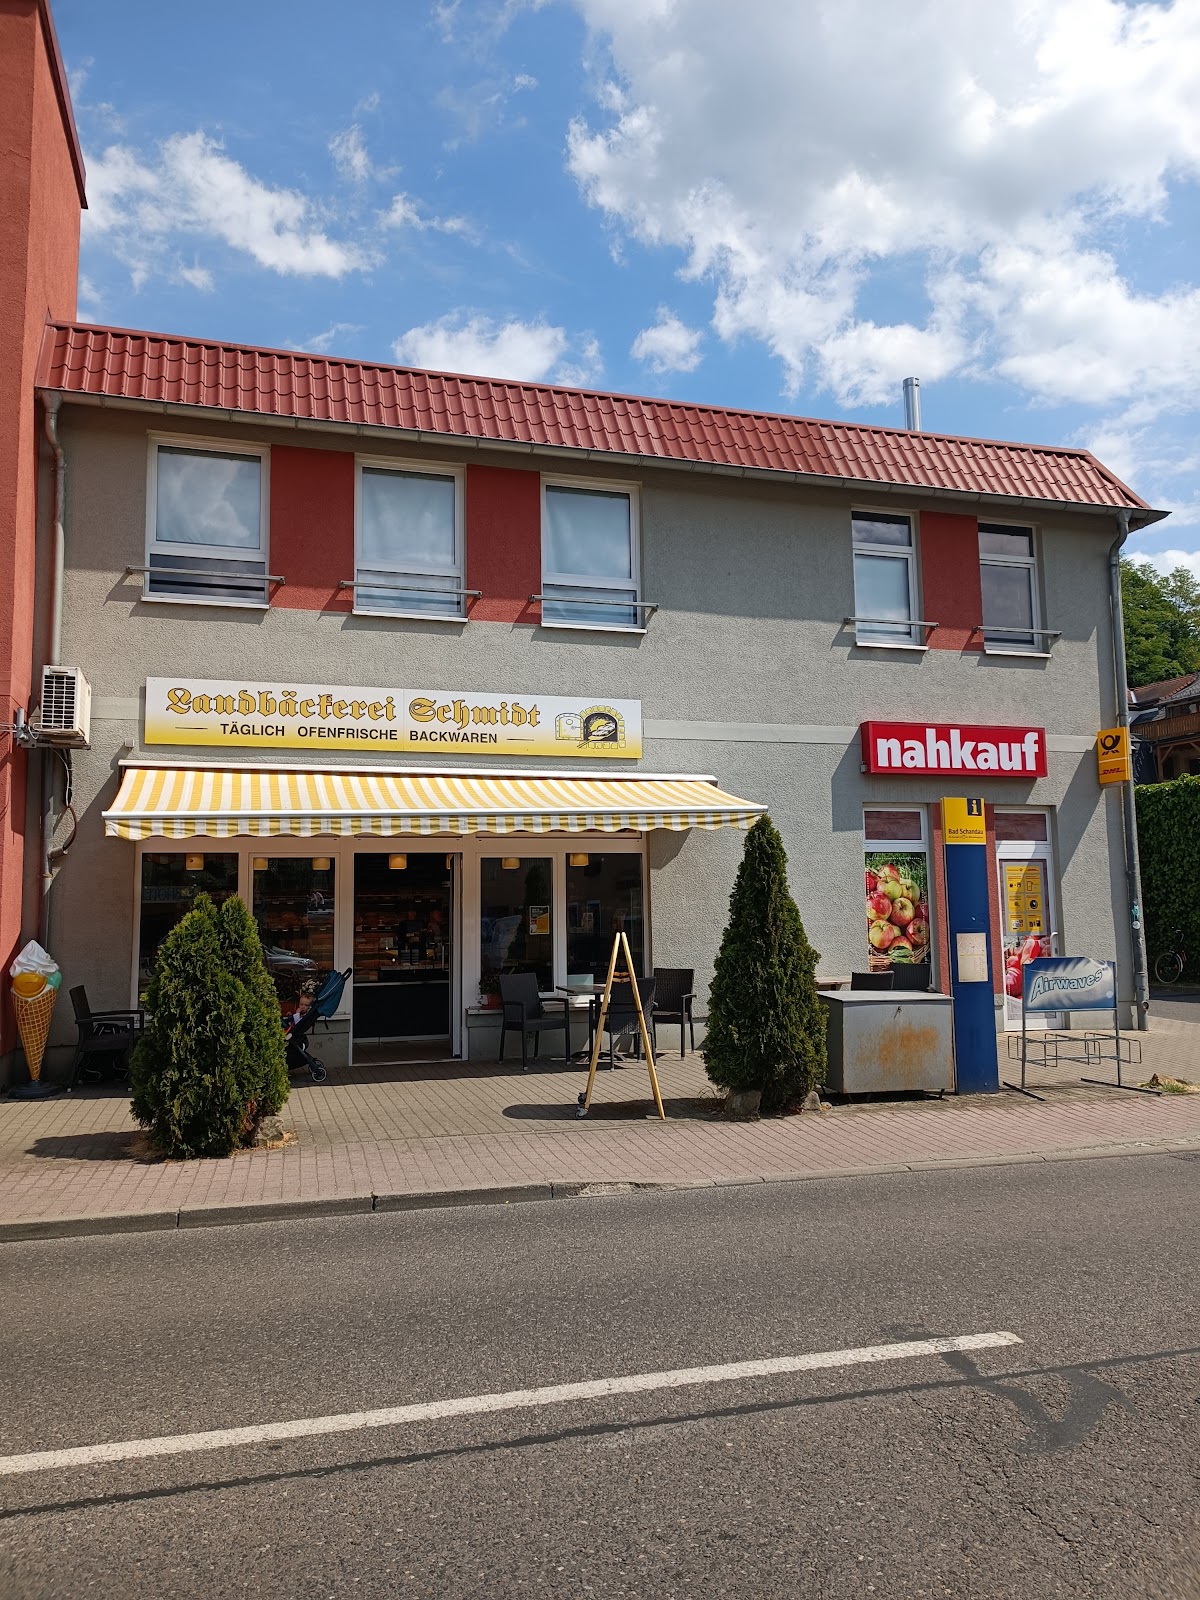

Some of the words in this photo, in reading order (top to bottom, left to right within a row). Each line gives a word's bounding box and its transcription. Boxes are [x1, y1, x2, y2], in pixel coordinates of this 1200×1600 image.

[166, 687, 396, 721] Landbäckerei
[409, 697, 540, 729] Schmidt
[220, 722, 285, 736] TÄGLICH
[297, 726, 398, 740] OFENFRISCHE
[409, 729, 498, 743] BACKWAREN
[876, 728, 1039, 771] nahkauf
[1031, 969, 1103, 1002] Airwaves
